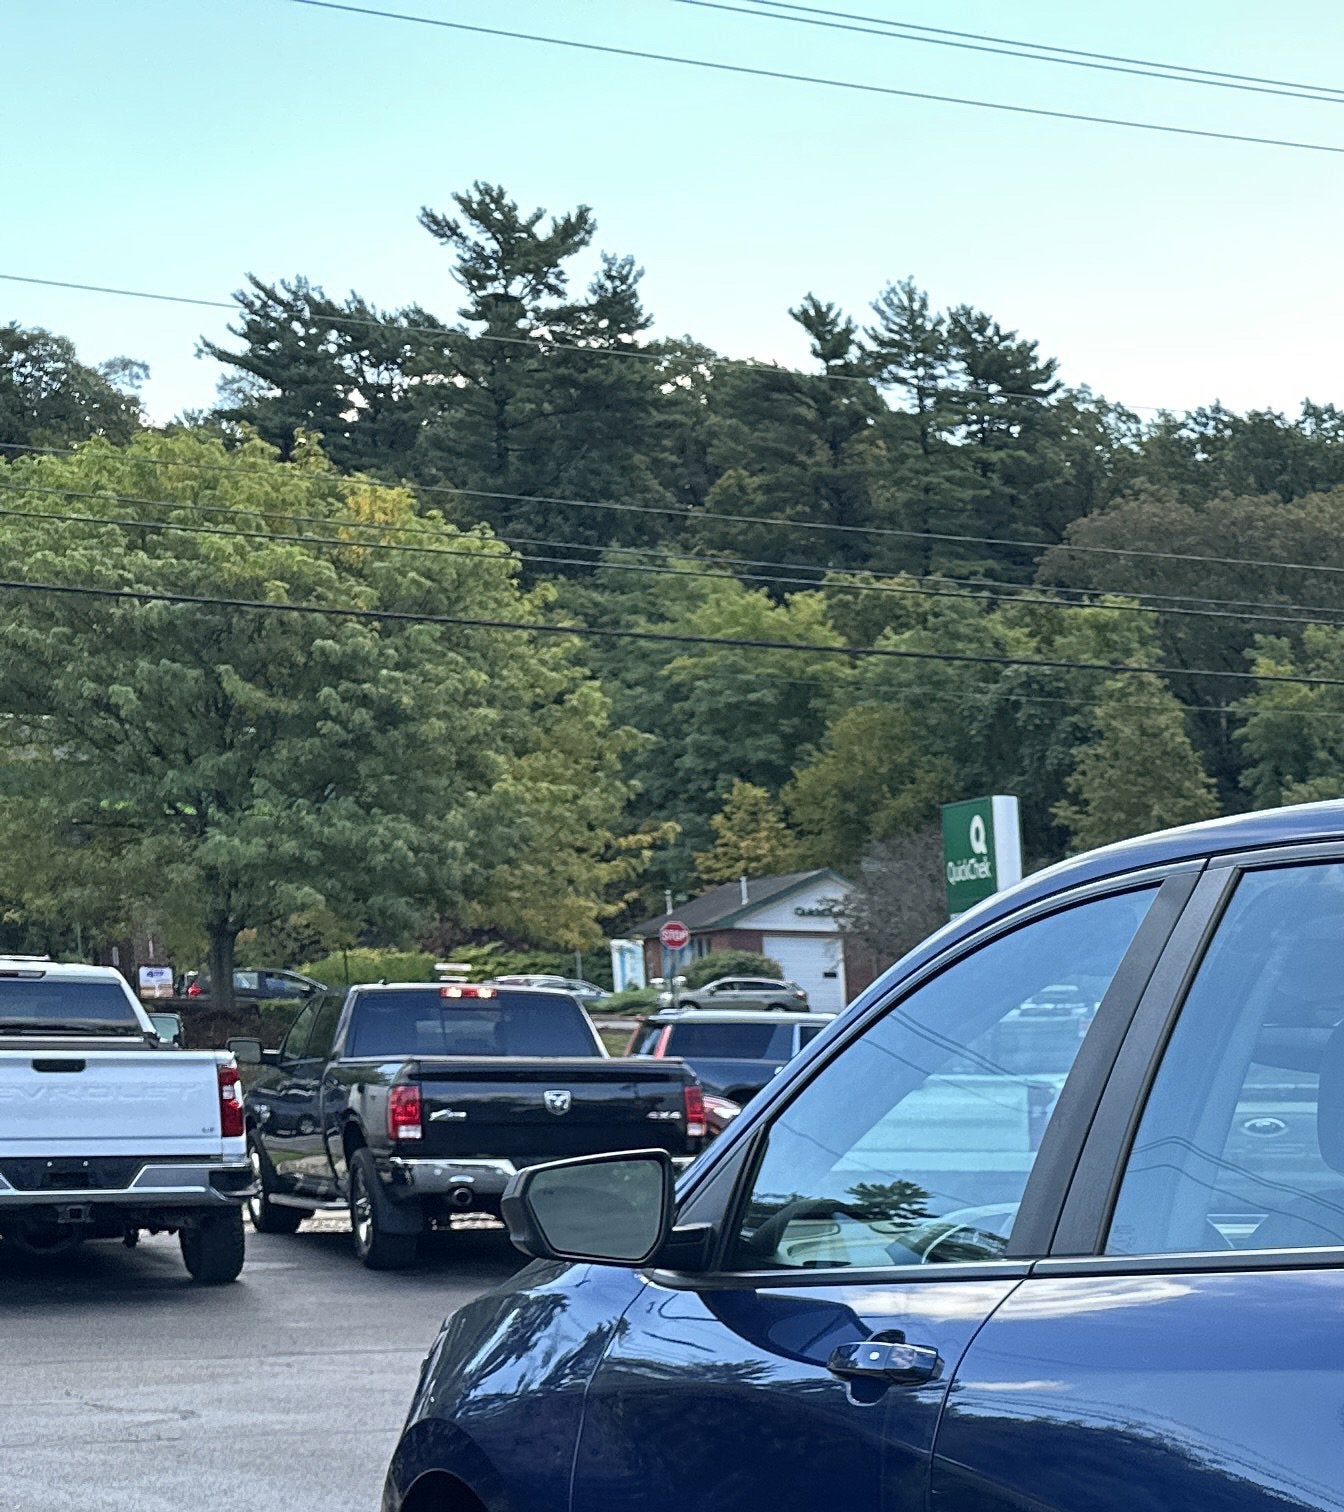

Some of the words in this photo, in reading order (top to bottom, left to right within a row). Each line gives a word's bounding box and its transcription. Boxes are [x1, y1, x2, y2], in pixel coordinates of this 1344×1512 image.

[969, 814, 988, 854] Q
[946, 856, 992, 885] QuickChek
[661, 929, 689, 941] STOP
